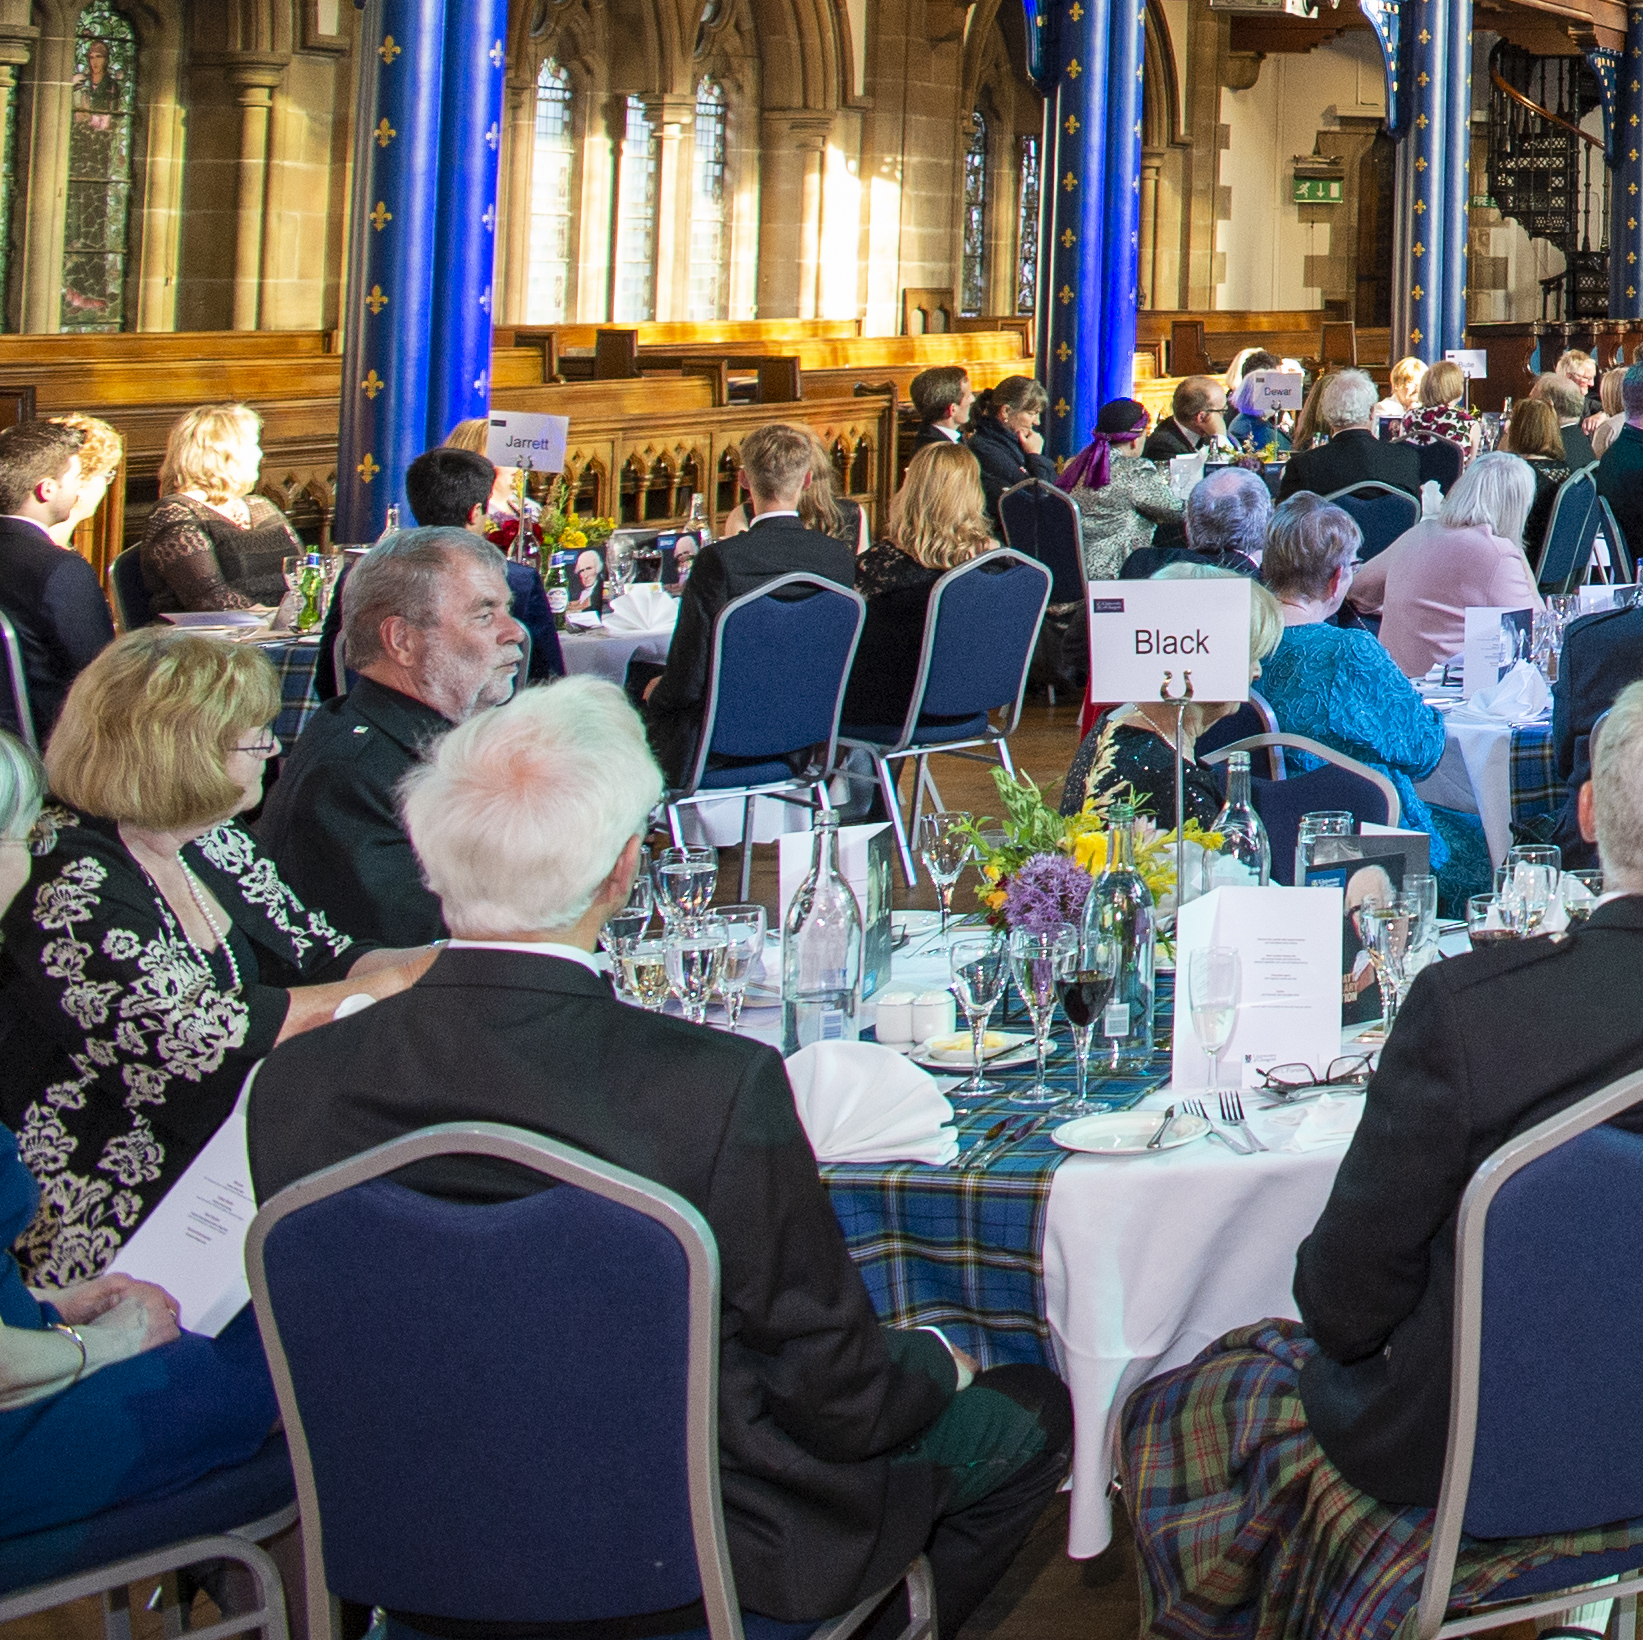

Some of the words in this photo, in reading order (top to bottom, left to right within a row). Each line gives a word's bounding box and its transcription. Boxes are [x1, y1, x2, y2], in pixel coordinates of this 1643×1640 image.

[1473, 195, 1488, 207] FIRE
[1264, 386, 1293, 396] Dewar
[505, 434, 550, 451] Jarrett
[1134, 628, 1210, 655] Black
